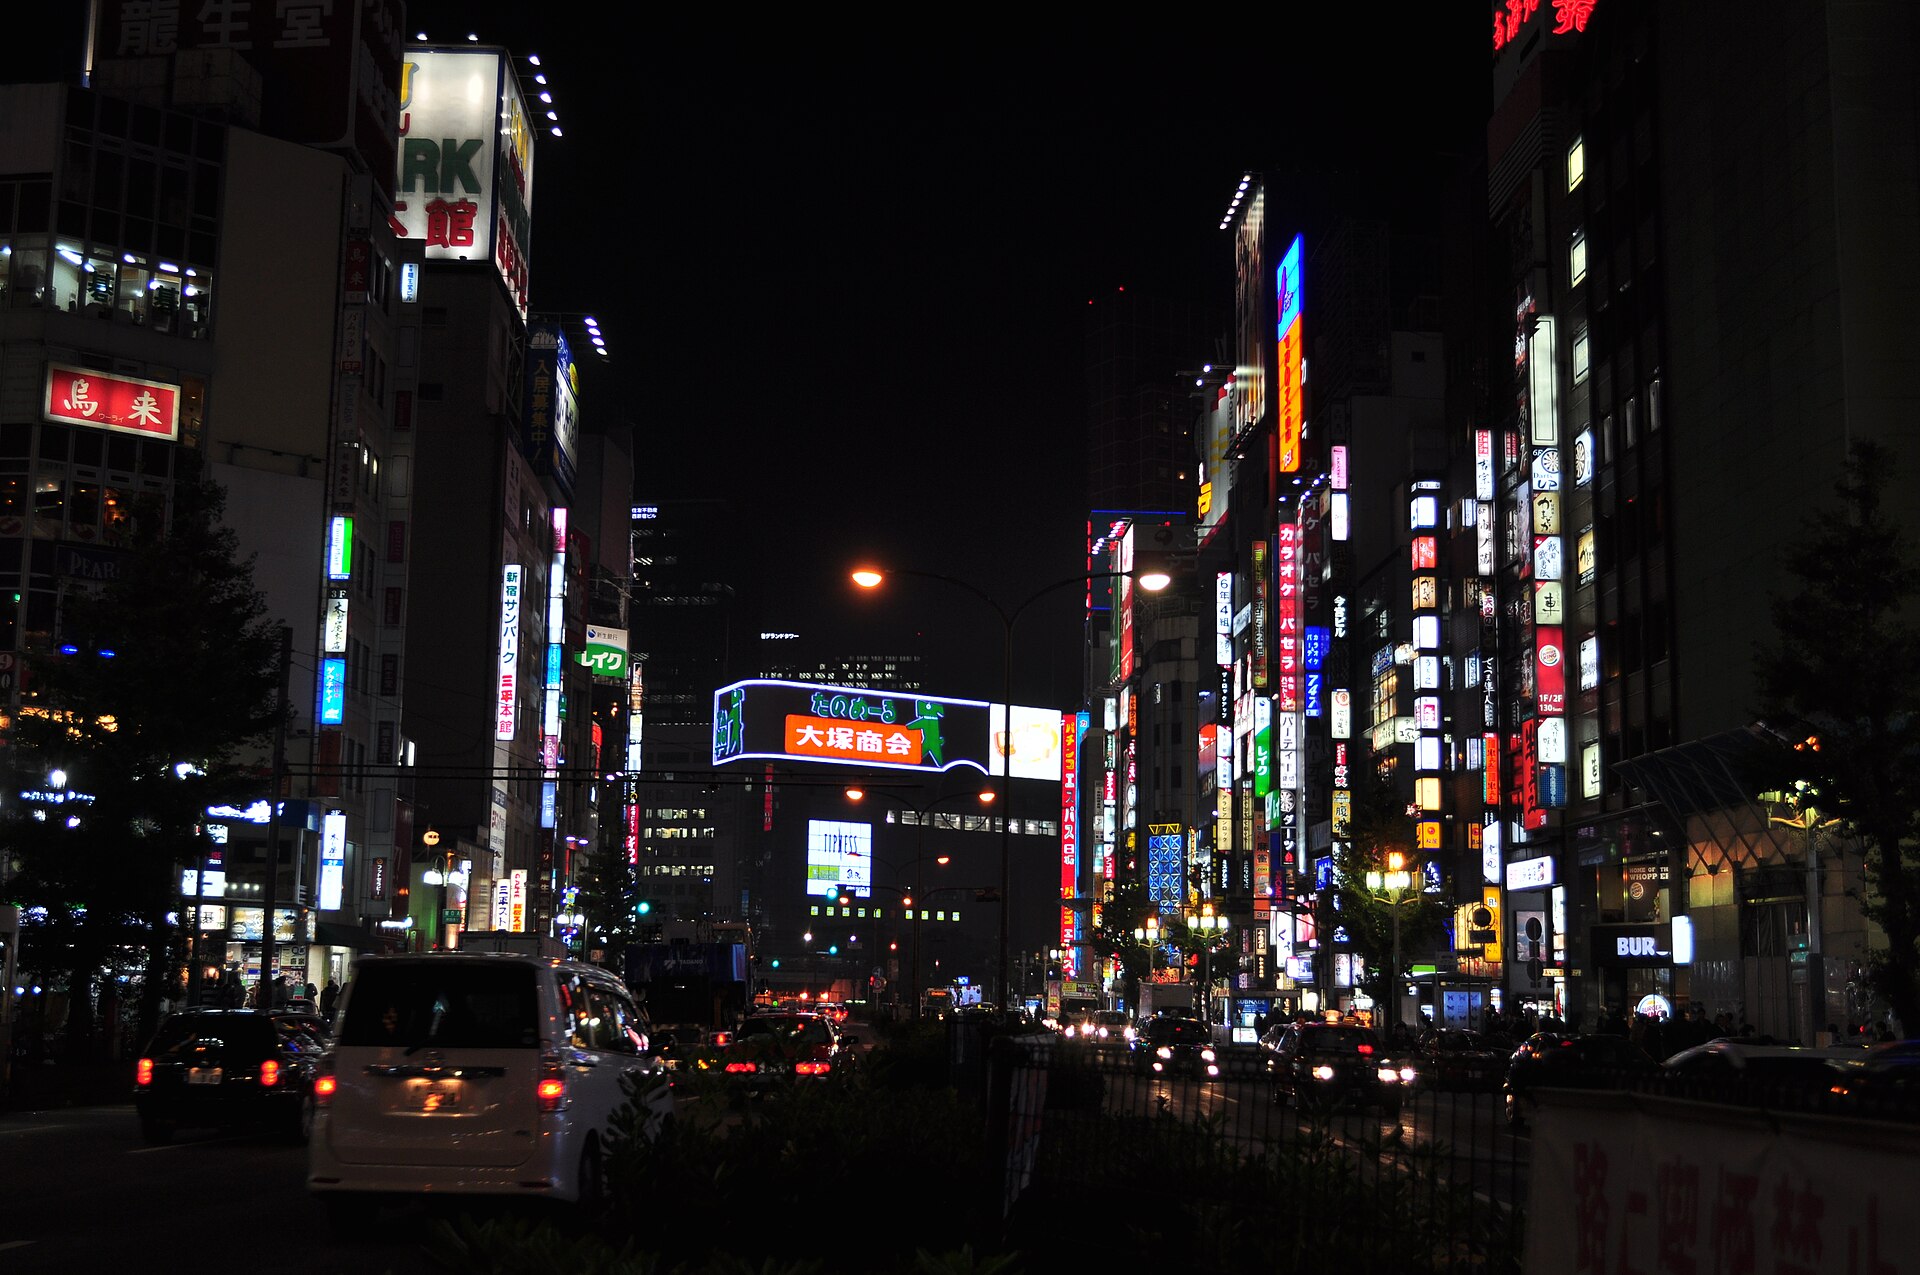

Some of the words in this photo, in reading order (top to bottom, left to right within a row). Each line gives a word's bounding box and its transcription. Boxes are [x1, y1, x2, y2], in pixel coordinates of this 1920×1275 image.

[117, 0, 335, 55] 龍生堂
[1280, 528, 1294, 597] カラオケ
[502, 571, 518, 664] 新宿サンパーク
[580, 650, 622, 671] レイク
[1280, 617, 1294, 670] パセラ
[499, 674, 513, 735] 三平本館
[811, 691, 897, 724] たのめーる
[1307, 675, 1319, 709] 747
[1539, 694, 1563, 703] 1F/2F
[1539, 704, 1552, 712] 130
[795, 725, 912, 756] 大塚商会
[1283, 717, 1294, 772] パーティー
[1257, 745, 1267, 777] レイク
[1283, 814, 1295, 852] ダーツ
